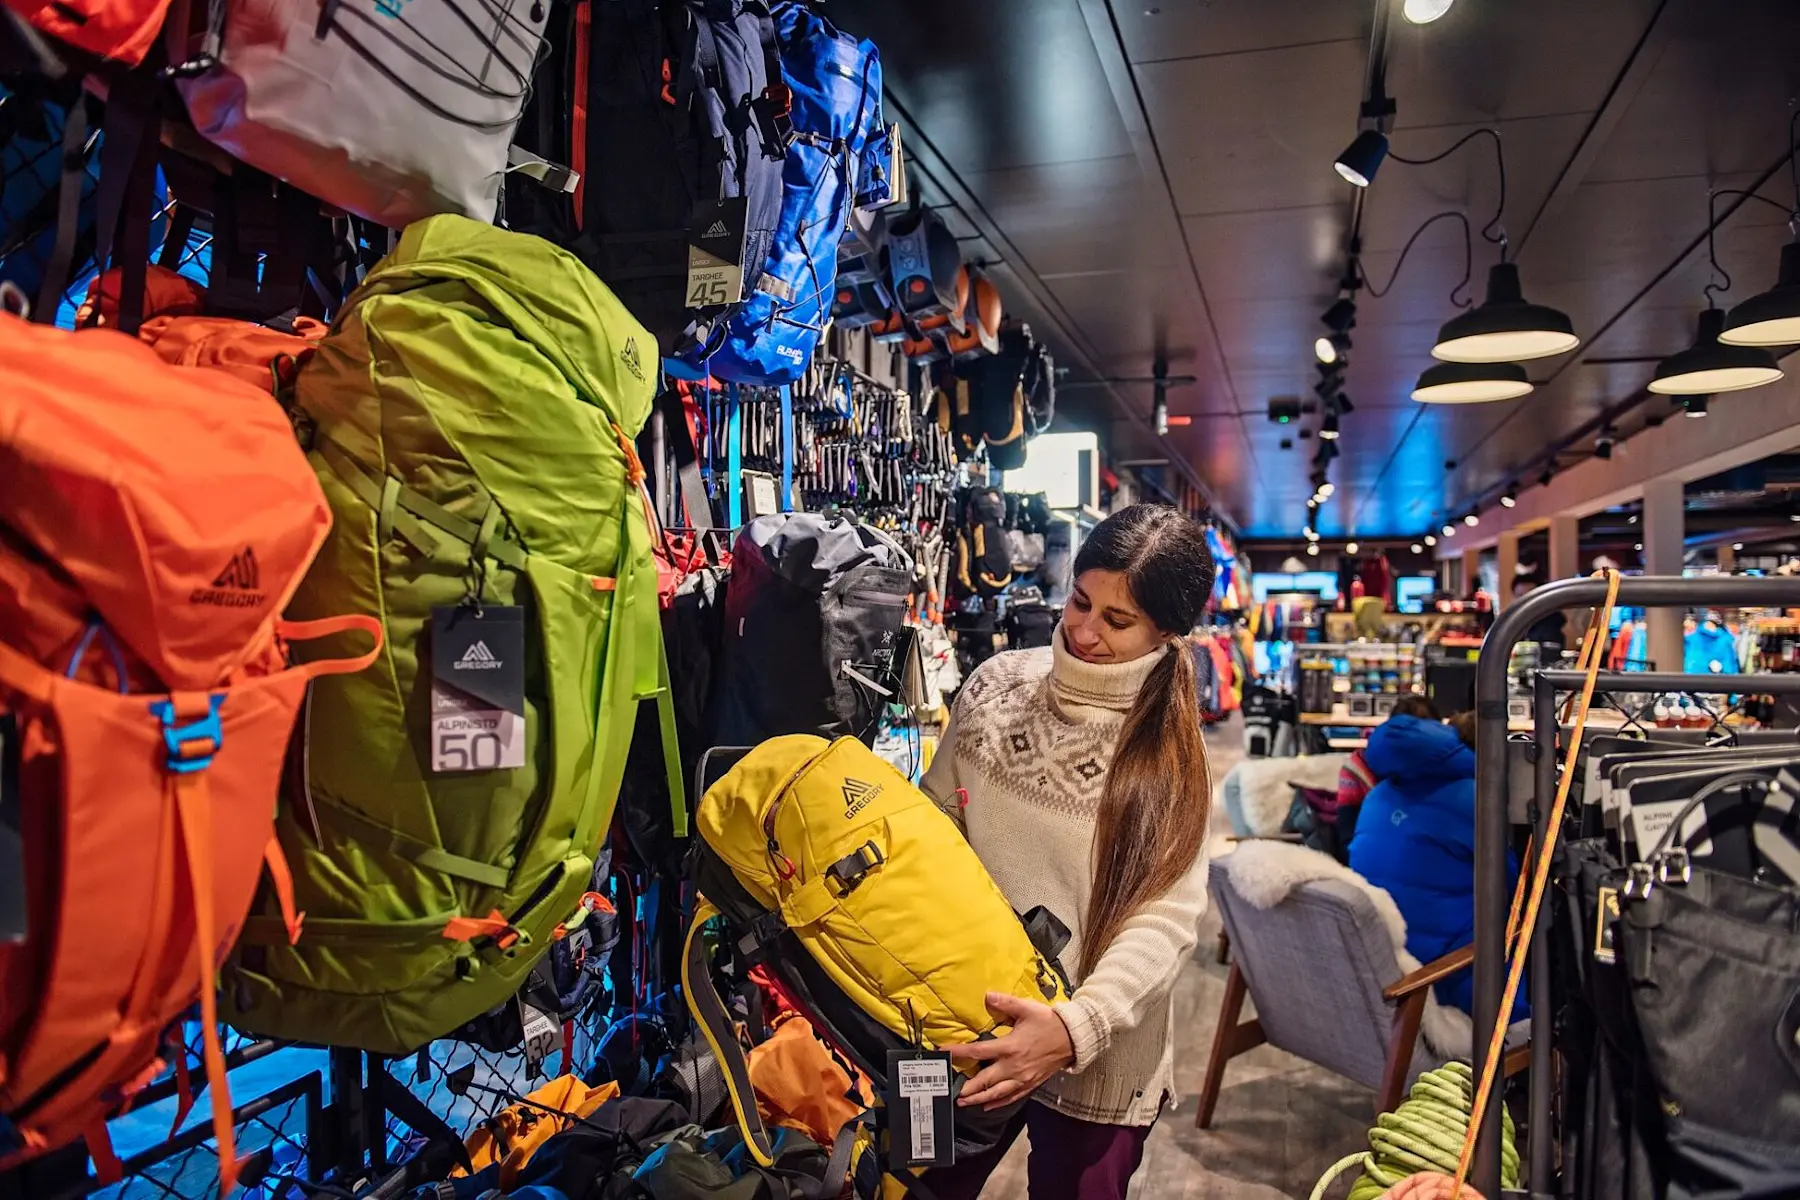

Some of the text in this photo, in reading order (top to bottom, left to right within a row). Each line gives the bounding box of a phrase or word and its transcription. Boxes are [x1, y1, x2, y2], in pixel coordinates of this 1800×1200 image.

[692, 272, 723, 281] TARGHEE
[689, 281, 728, 305] 45
[453, 660, 503, 670] GREGORY
[437, 719, 498, 730] ALPINISTO
[438, 732, 501, 770] 50
[844, 783, 884, 820] GREGORY
